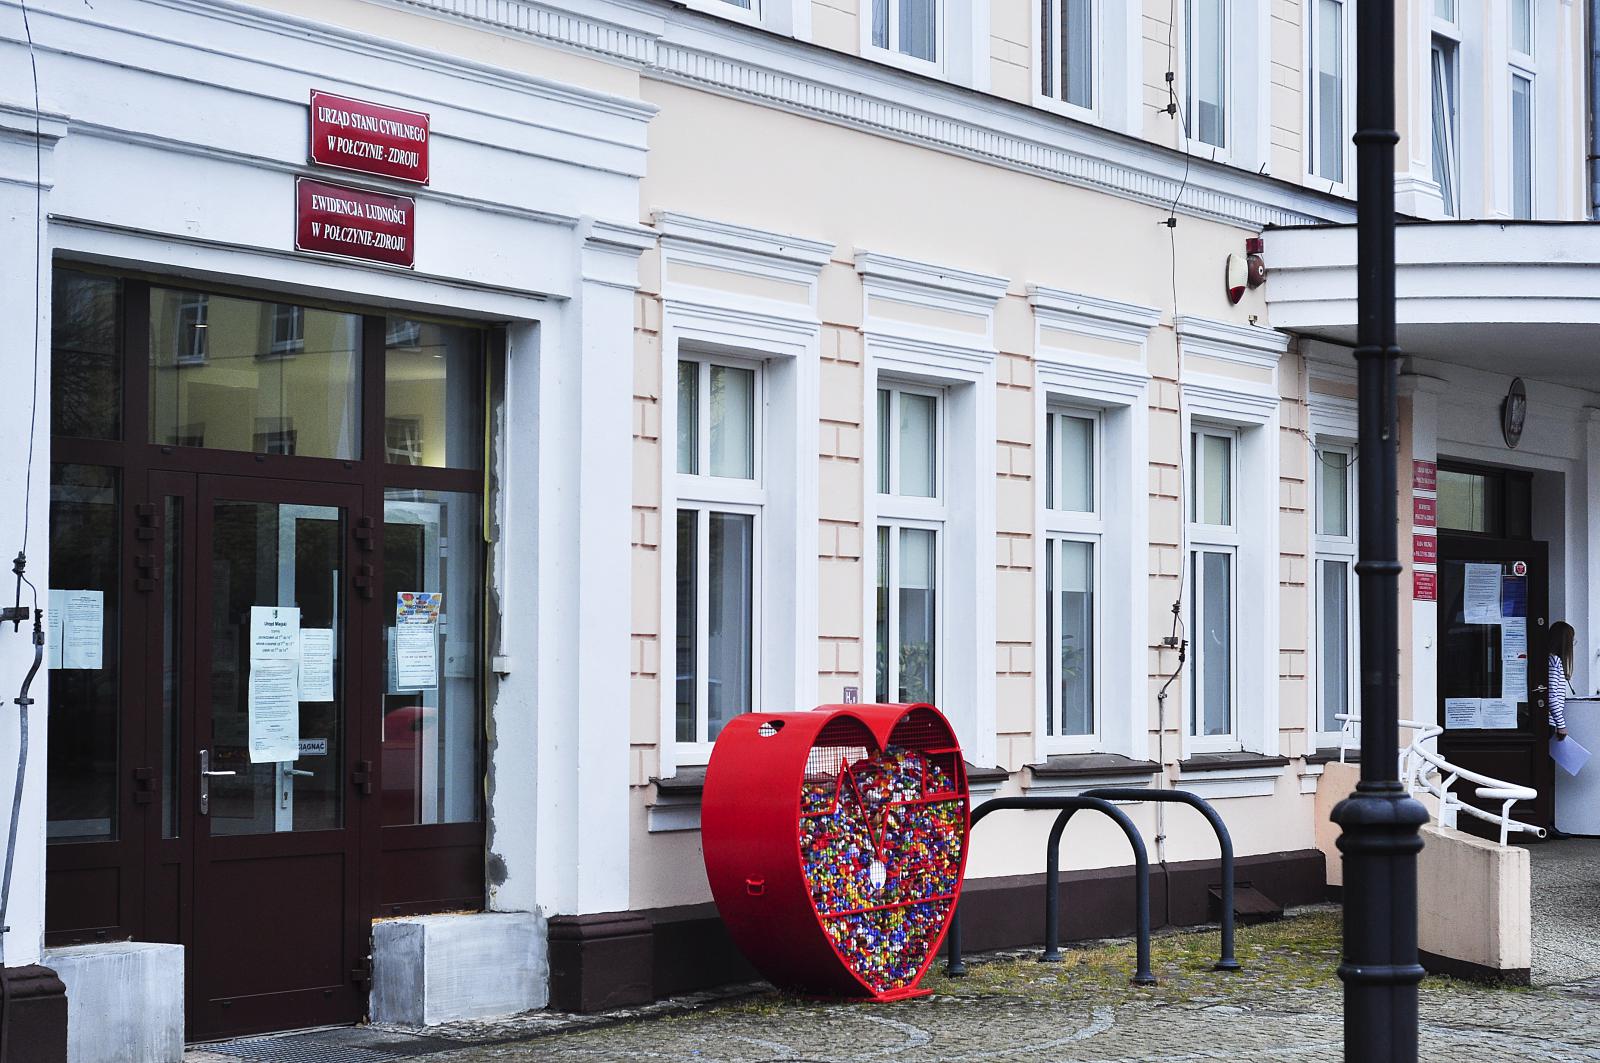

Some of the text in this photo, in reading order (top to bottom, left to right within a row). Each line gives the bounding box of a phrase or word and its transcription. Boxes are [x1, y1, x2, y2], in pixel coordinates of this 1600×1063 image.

[318, 106, 426, 143] URZĄD STANU CYWILNEGO
[327, 135, 336, 151] W
[337, 137, 384, 161] POŁCZYNIE
[388, 147, 419, 169] ZDROJU
[312, 194, 406, 225] EWIDENCJA LUDNOŚCI
[312, 222, 406, 252] W POŁCZYNIE-ZDROJU
